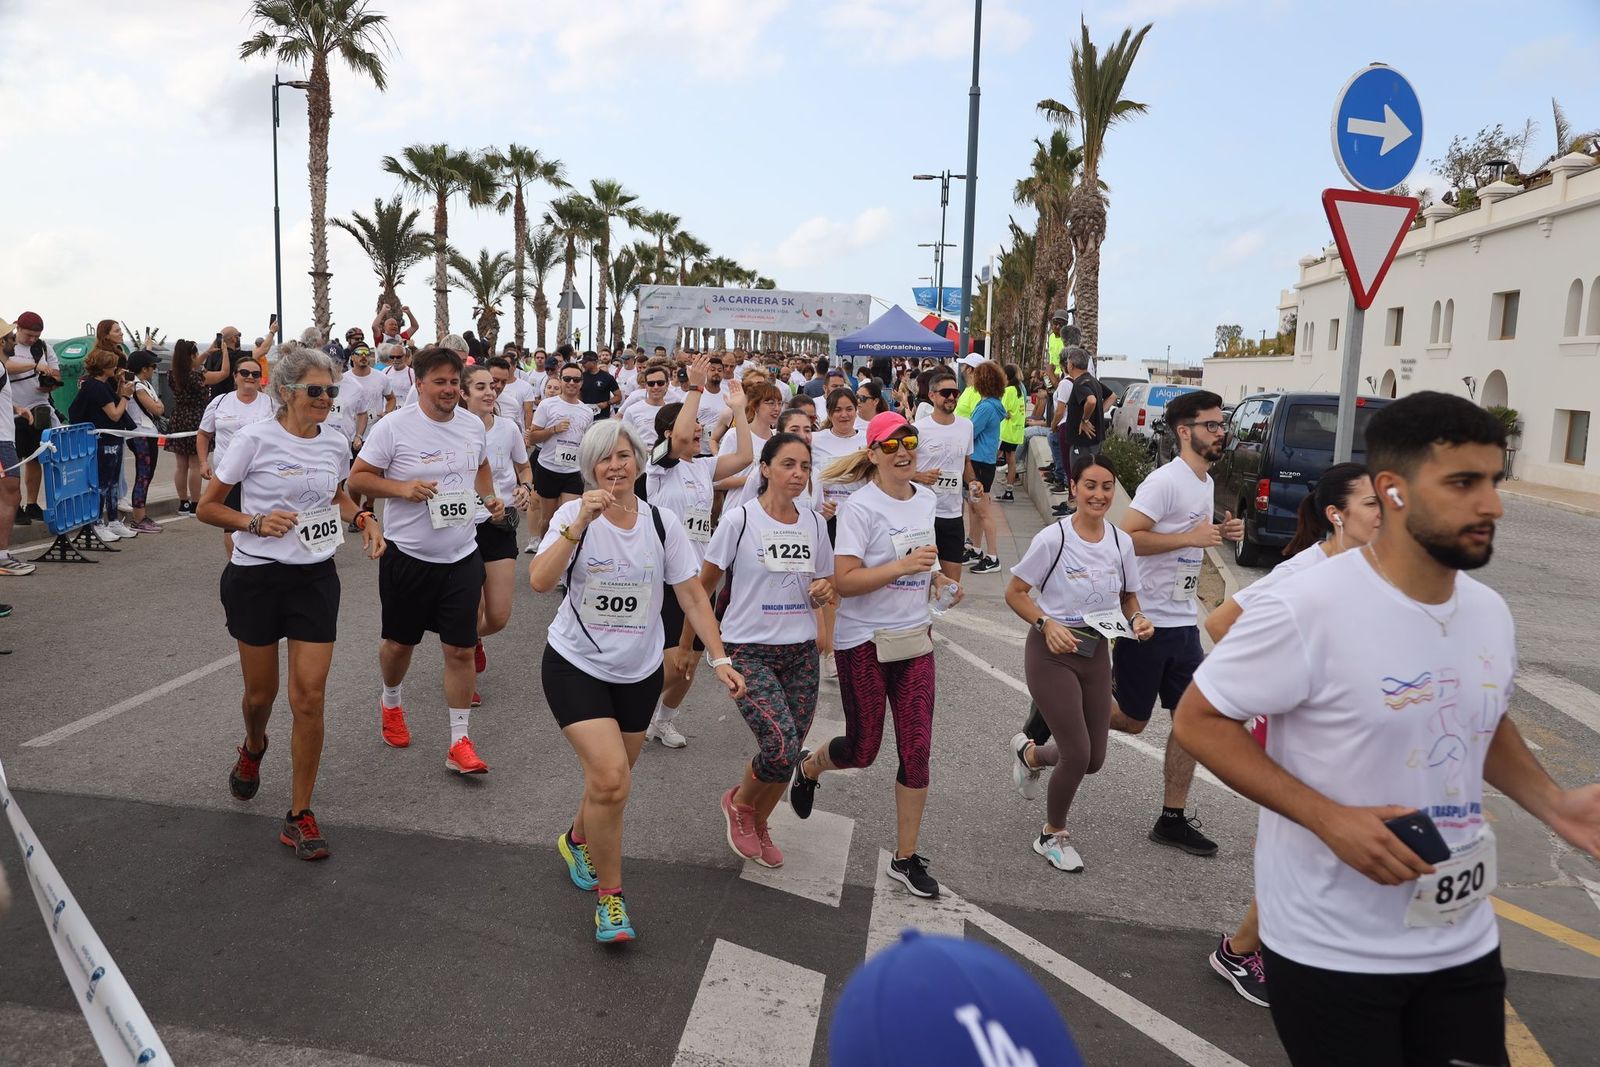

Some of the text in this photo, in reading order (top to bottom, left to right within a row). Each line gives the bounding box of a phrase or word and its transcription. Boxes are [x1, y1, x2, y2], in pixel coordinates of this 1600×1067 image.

[712, 294, 795, 306] 3A CARRERA 5K
[560, 452, 577, 462] 104
[937, 477, 958, 487] 775
[439, 502, 467, 517] 856
[300, 519, 338, 542] 1205
[768, 543, 811, 560] 1225
[594, 595, 638, 612] 309
[1434, 861, 1485, 906] 820
